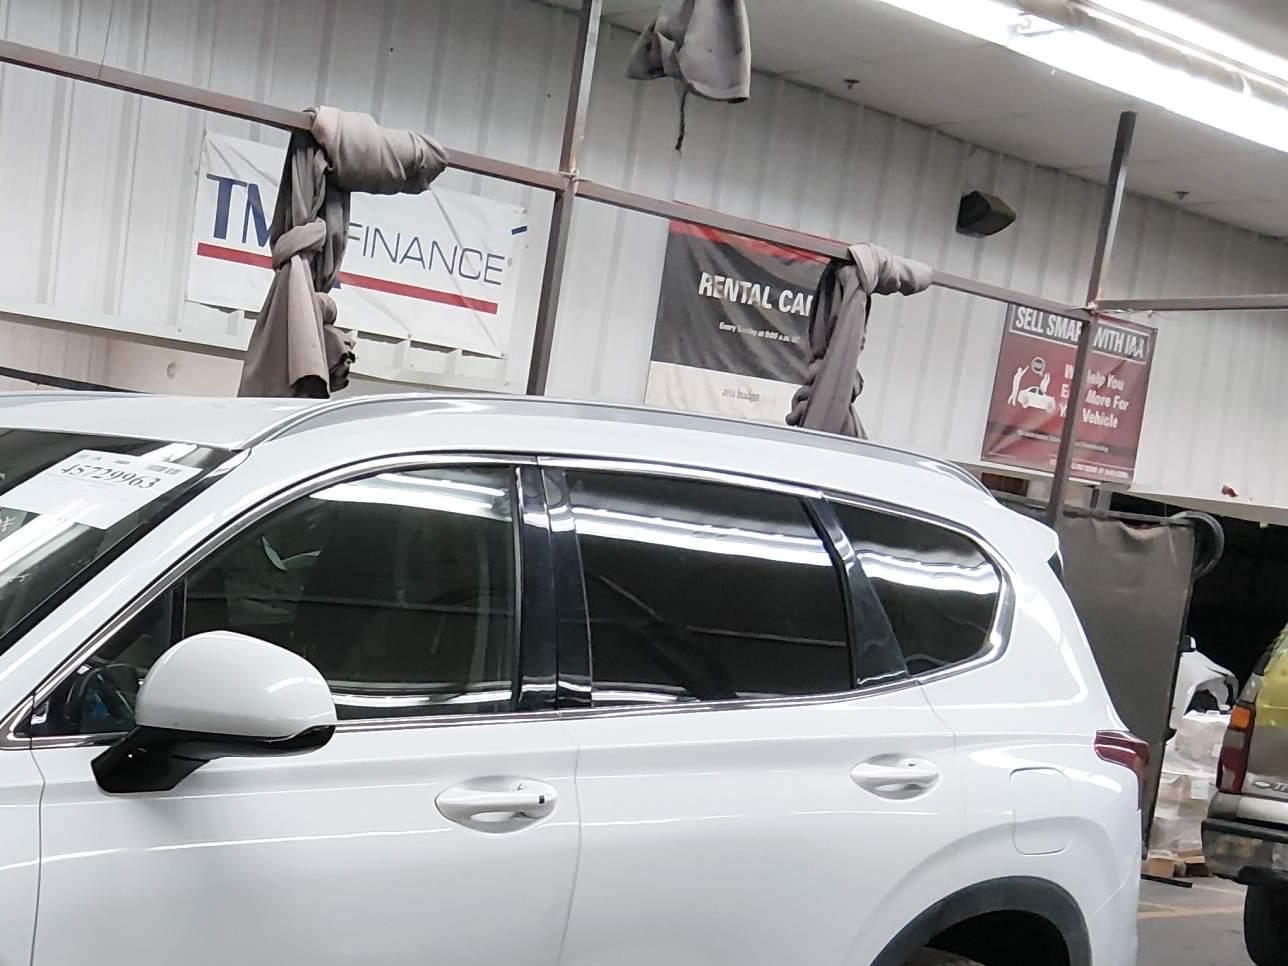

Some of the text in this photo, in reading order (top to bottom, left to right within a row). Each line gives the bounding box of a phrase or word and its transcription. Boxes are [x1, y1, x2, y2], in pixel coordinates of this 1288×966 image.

[698, 272, 772, 309] RENTAL
[1015, 306, 1044, 333] SELL
[1046, 314, 1083, 342] SMAR
[1107, 374, 1125, 391] You
[1085, 389, 1111, 407] More
[1112, 395, 1130, 411] For
[1082, 408, 1119, 429] Vehicle
[60, 463, 162, 489] 45729963
